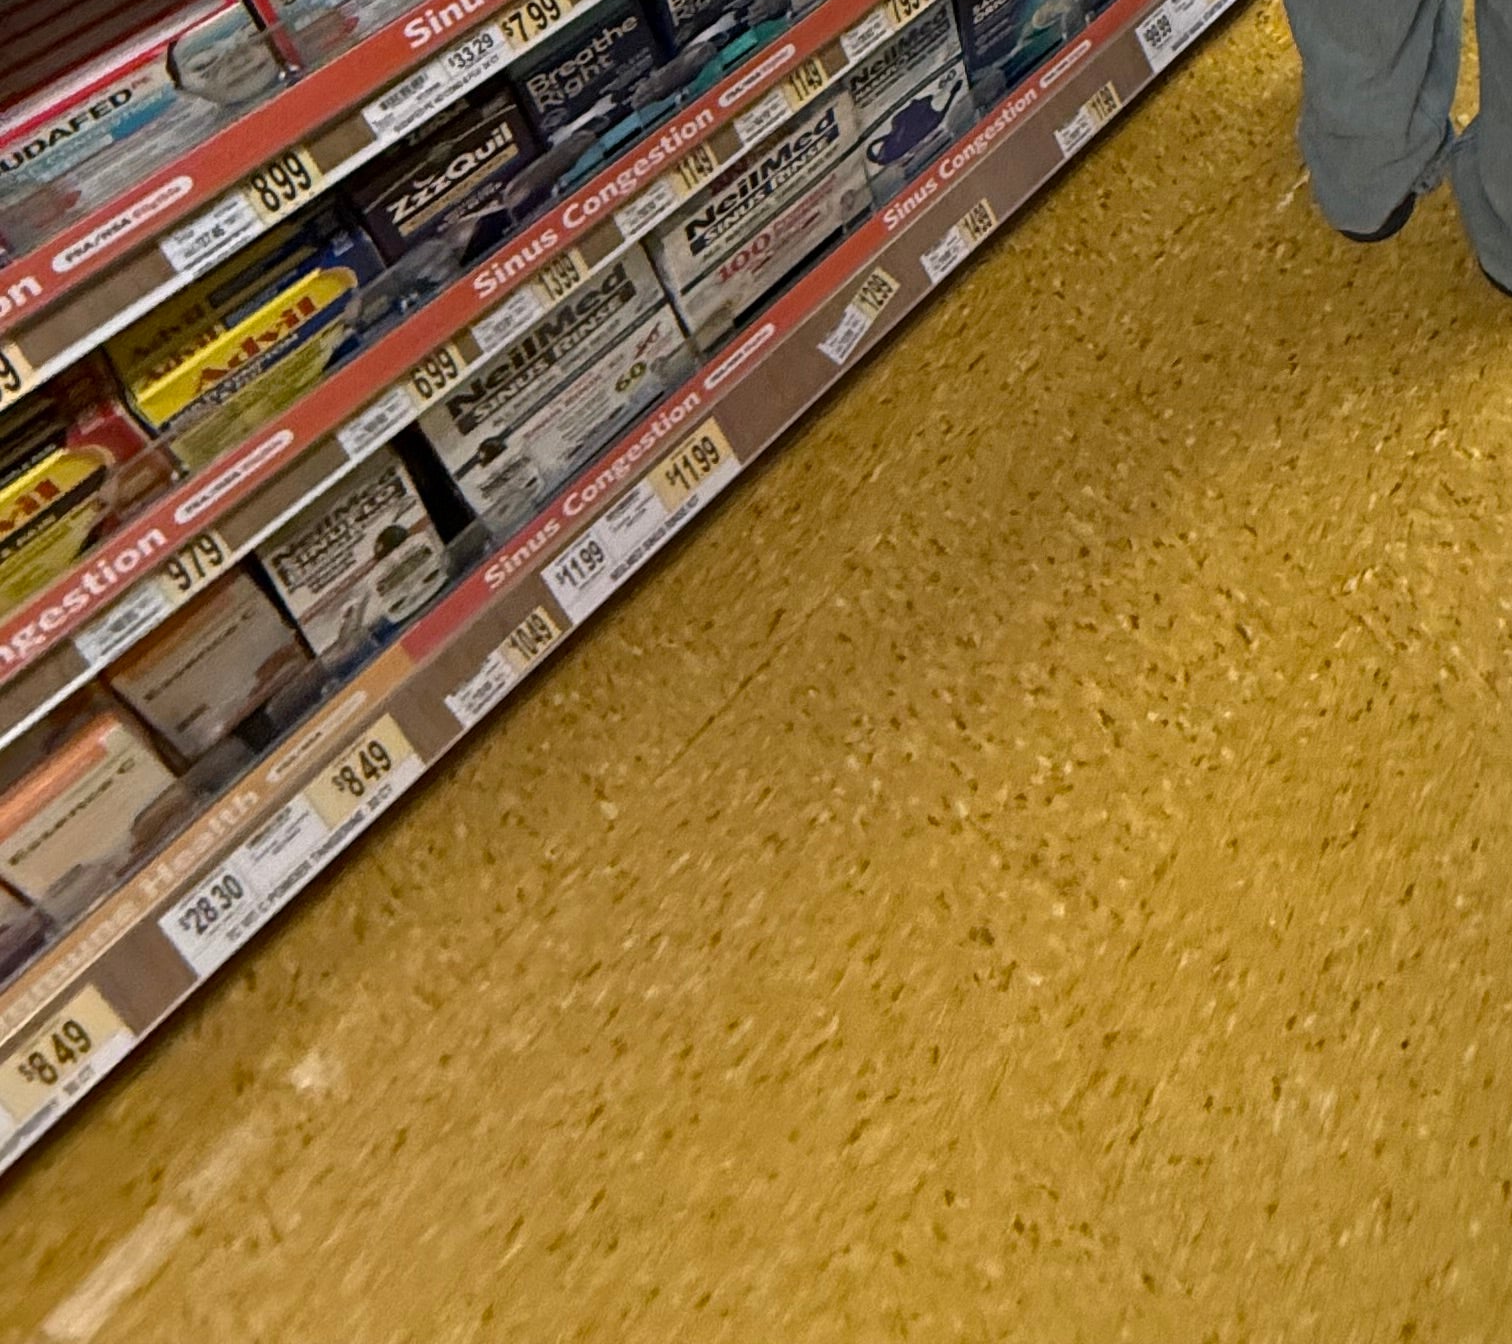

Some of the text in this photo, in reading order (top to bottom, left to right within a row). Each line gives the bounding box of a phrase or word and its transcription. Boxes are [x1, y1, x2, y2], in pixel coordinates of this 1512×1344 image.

[526, 13, 641, 96] Breathe
[0, 89, 134, 173] UDAFED
[684, 108, 835, 245] NeilMed
[883, 178, 939, 231] Sinus
[939, 88, 1039, 179] Congestion
[472, 108, 716, 301] Sinus Congestion
[718, 234, 772, 282] 100
[445, 262, 628, 420] NeilMed
[614, 362, 647, 394] 60
[483, 516, 562, 591] Sinus
[561, 392, 702, 518] Congestion
